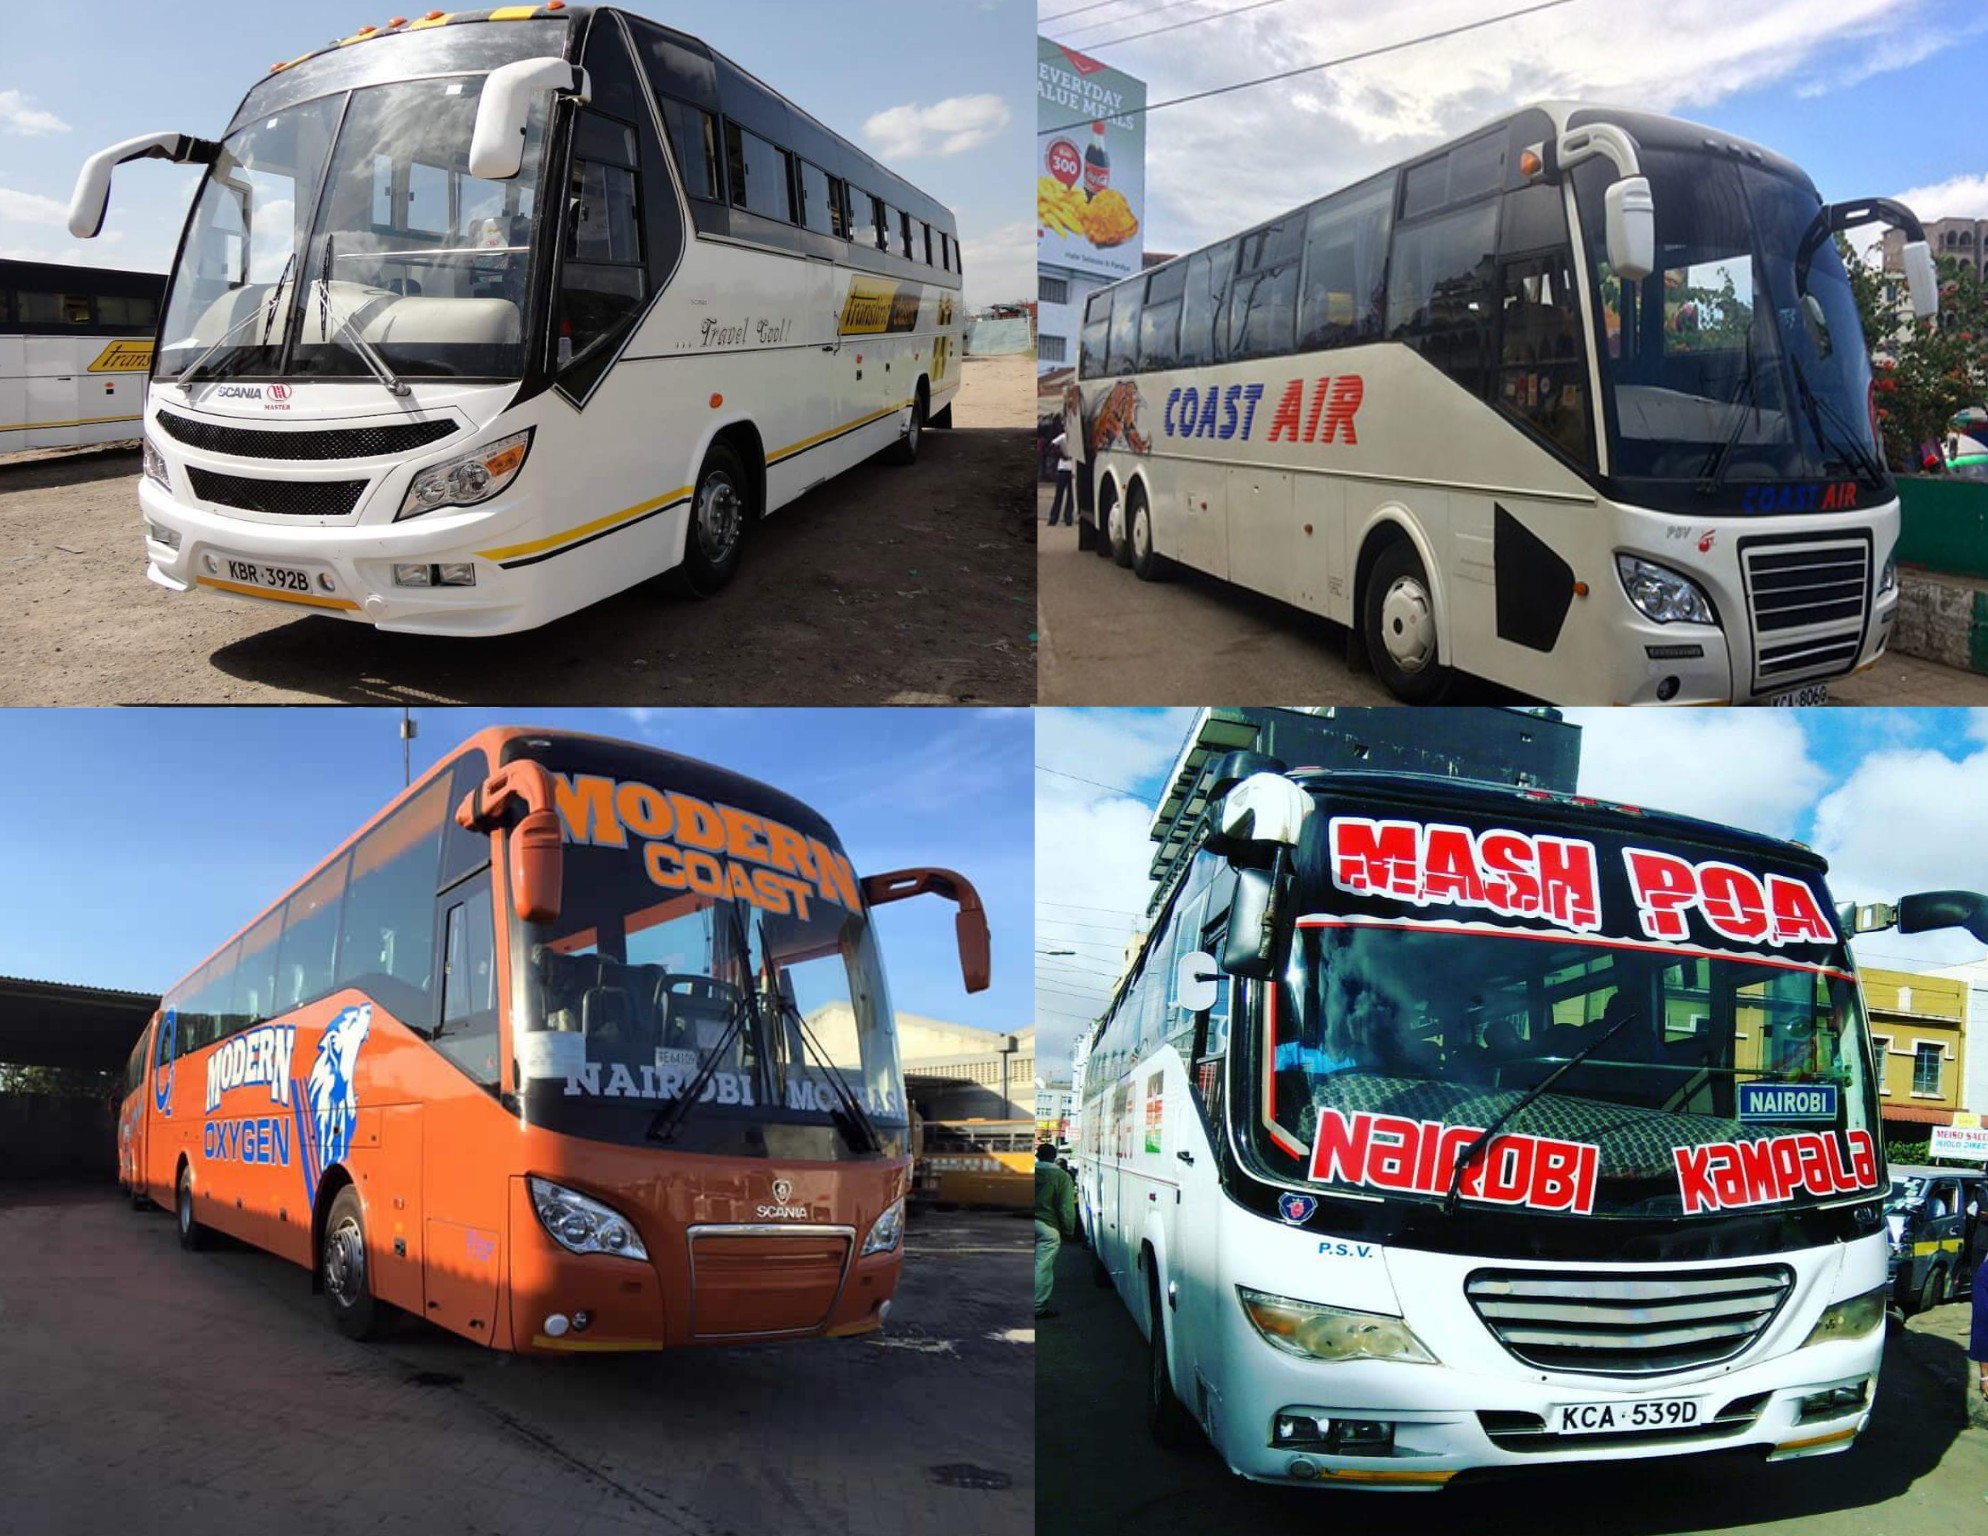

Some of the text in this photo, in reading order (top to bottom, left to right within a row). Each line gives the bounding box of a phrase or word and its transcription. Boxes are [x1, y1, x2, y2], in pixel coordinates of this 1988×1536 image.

[1038, 61, 1122, 109] EVERYDAY
[1051, 155, 1078, 175] 300
[700, 317, 750, 347] Travel
[218, 386, 262, 400] SCANIA
[1164, 373, 1365, 446] COAST AIR
[1743, 481, 1858, 516] COAST AIR
[553, 772, 864, 917] MODERN
[643, 841, 814, 923] COAST
[1328, 815, 1839, 948] MASH POA
[205, 1023, 296, 1115] MODERN
[1750, 1091, 1827, 1113] NAIROBI
[204, 1117, 290, 1167] OXYGEN
[756, 1205, 808, 1218] SCANIA
[1318, 1242, 1373, 1258] P.S.V.
